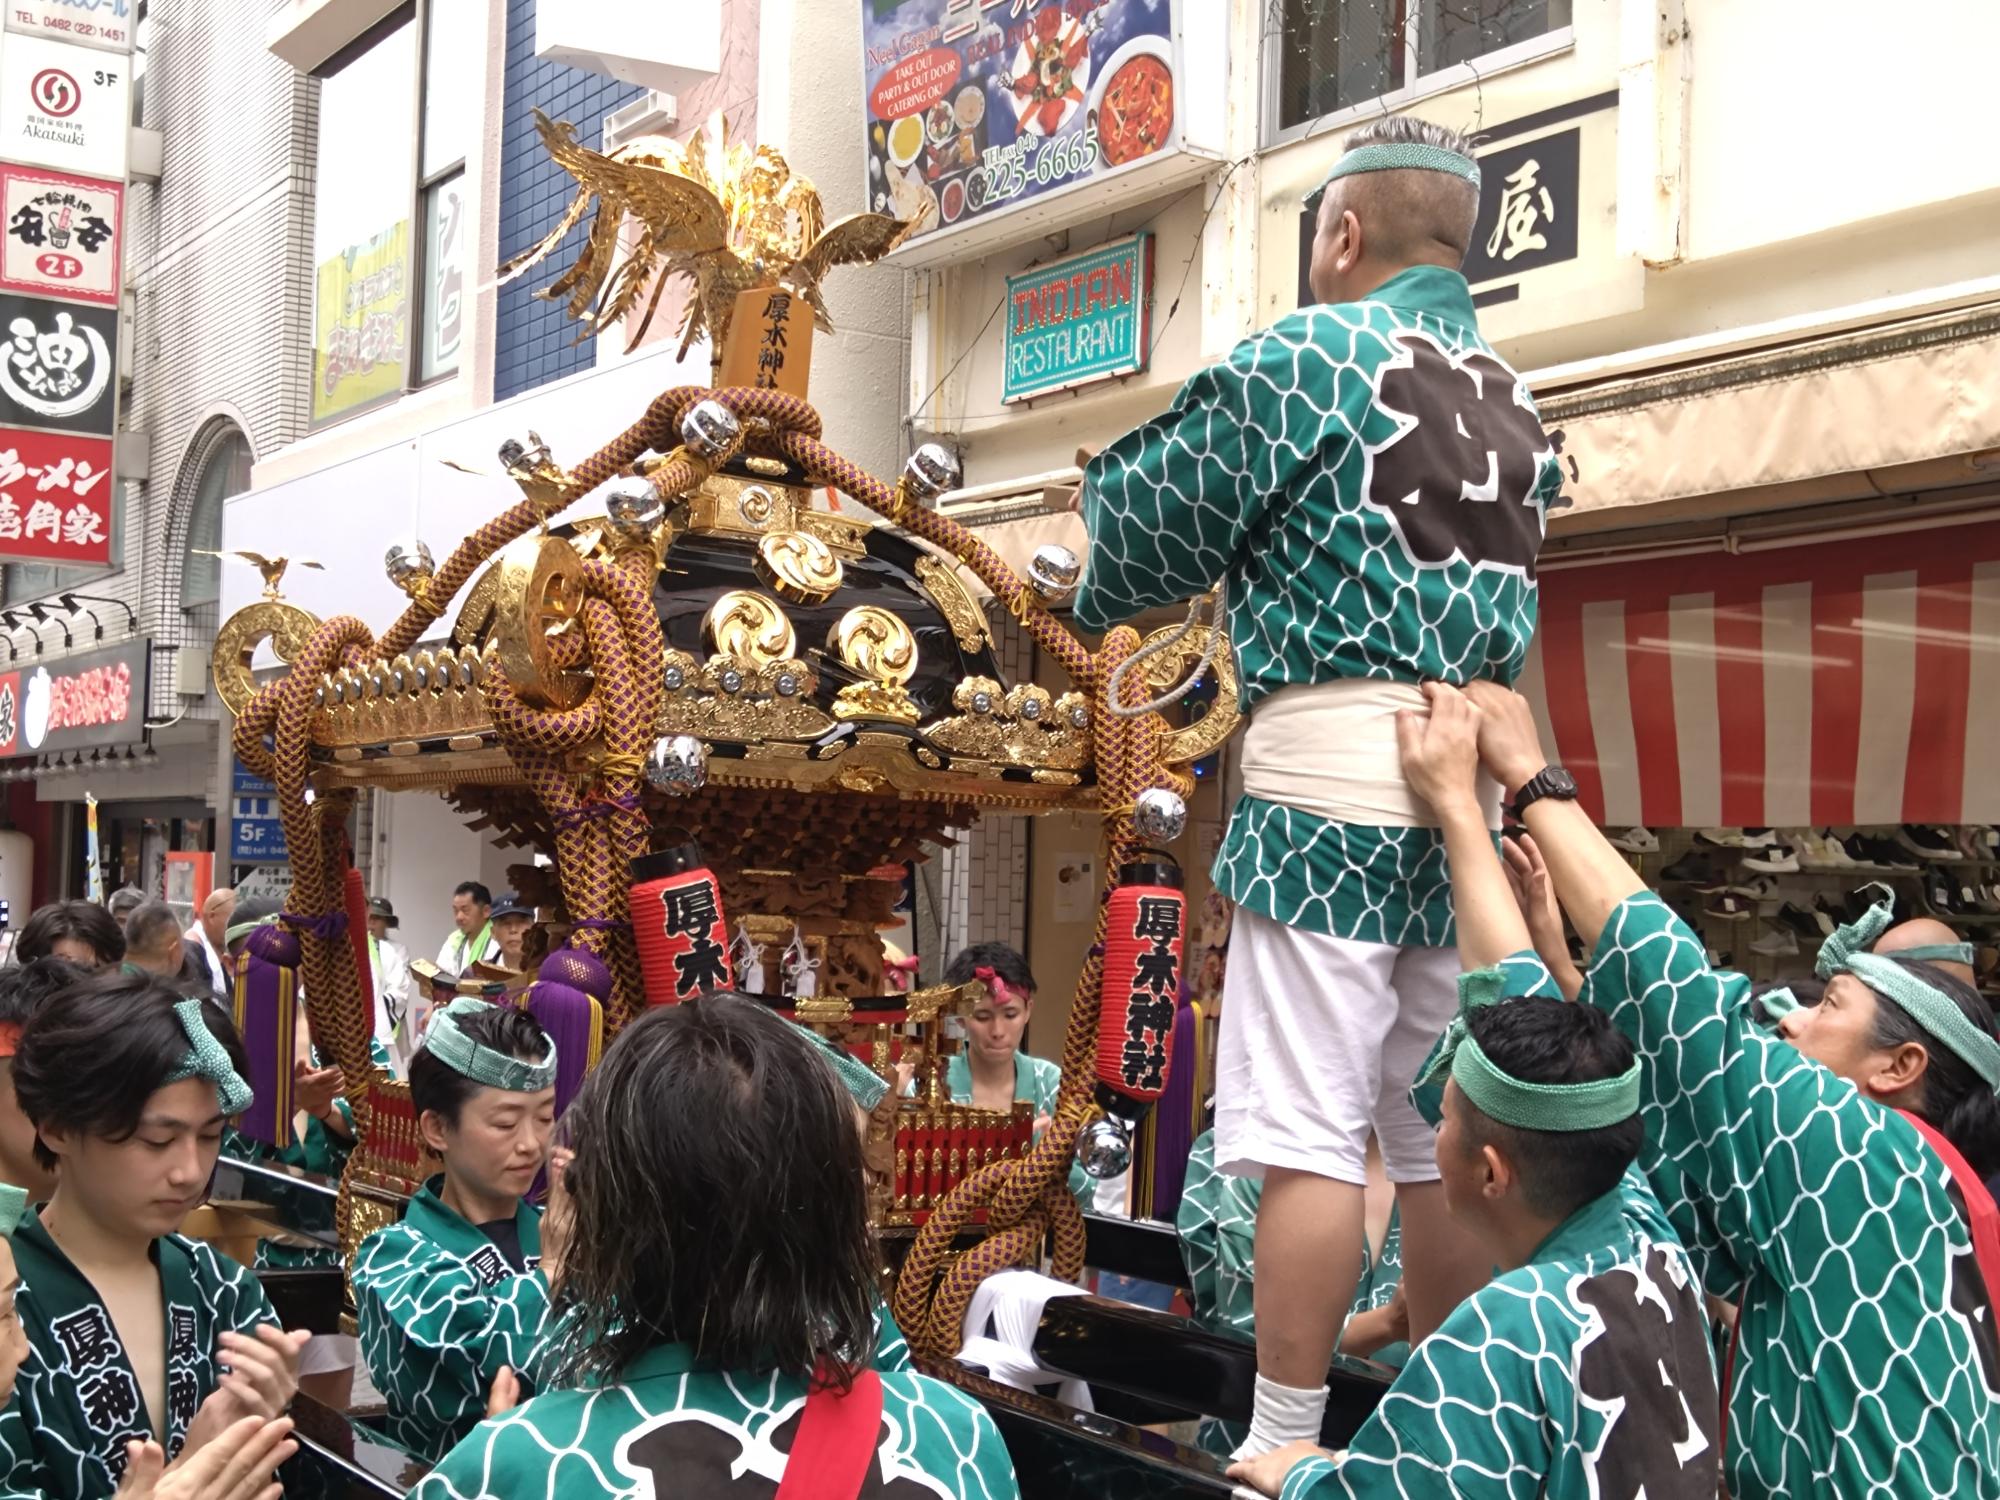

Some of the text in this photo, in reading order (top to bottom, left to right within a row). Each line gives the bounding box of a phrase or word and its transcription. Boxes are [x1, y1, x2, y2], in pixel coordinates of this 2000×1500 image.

[15, 10, 37, 25] TEL
[99, 27, 126, 42] 1451
[93, 70, 118, 88] 3F
[877, 59, 956, 104] PARTY & OUT DOOR
[894, 54, 933, 81] TAKE OUT
[887, 81, 944, 117] CATERING OK!
[22, 124, 85, 147] Akatsuki
[983, 127, 1100, 204] 225-6665
[43, 255, 76, 277] 2F
[1013, 257, 1133, 336] INDIAN
[1010, 311, 1130, 380] RESTAURANT
[0, 447, 110, 497] ラーメン
[239, 822, 266, 842] 5F
[659, 877, 730, 999] 厚木
[1120, 895, 1184, 1092] 厚木神社
